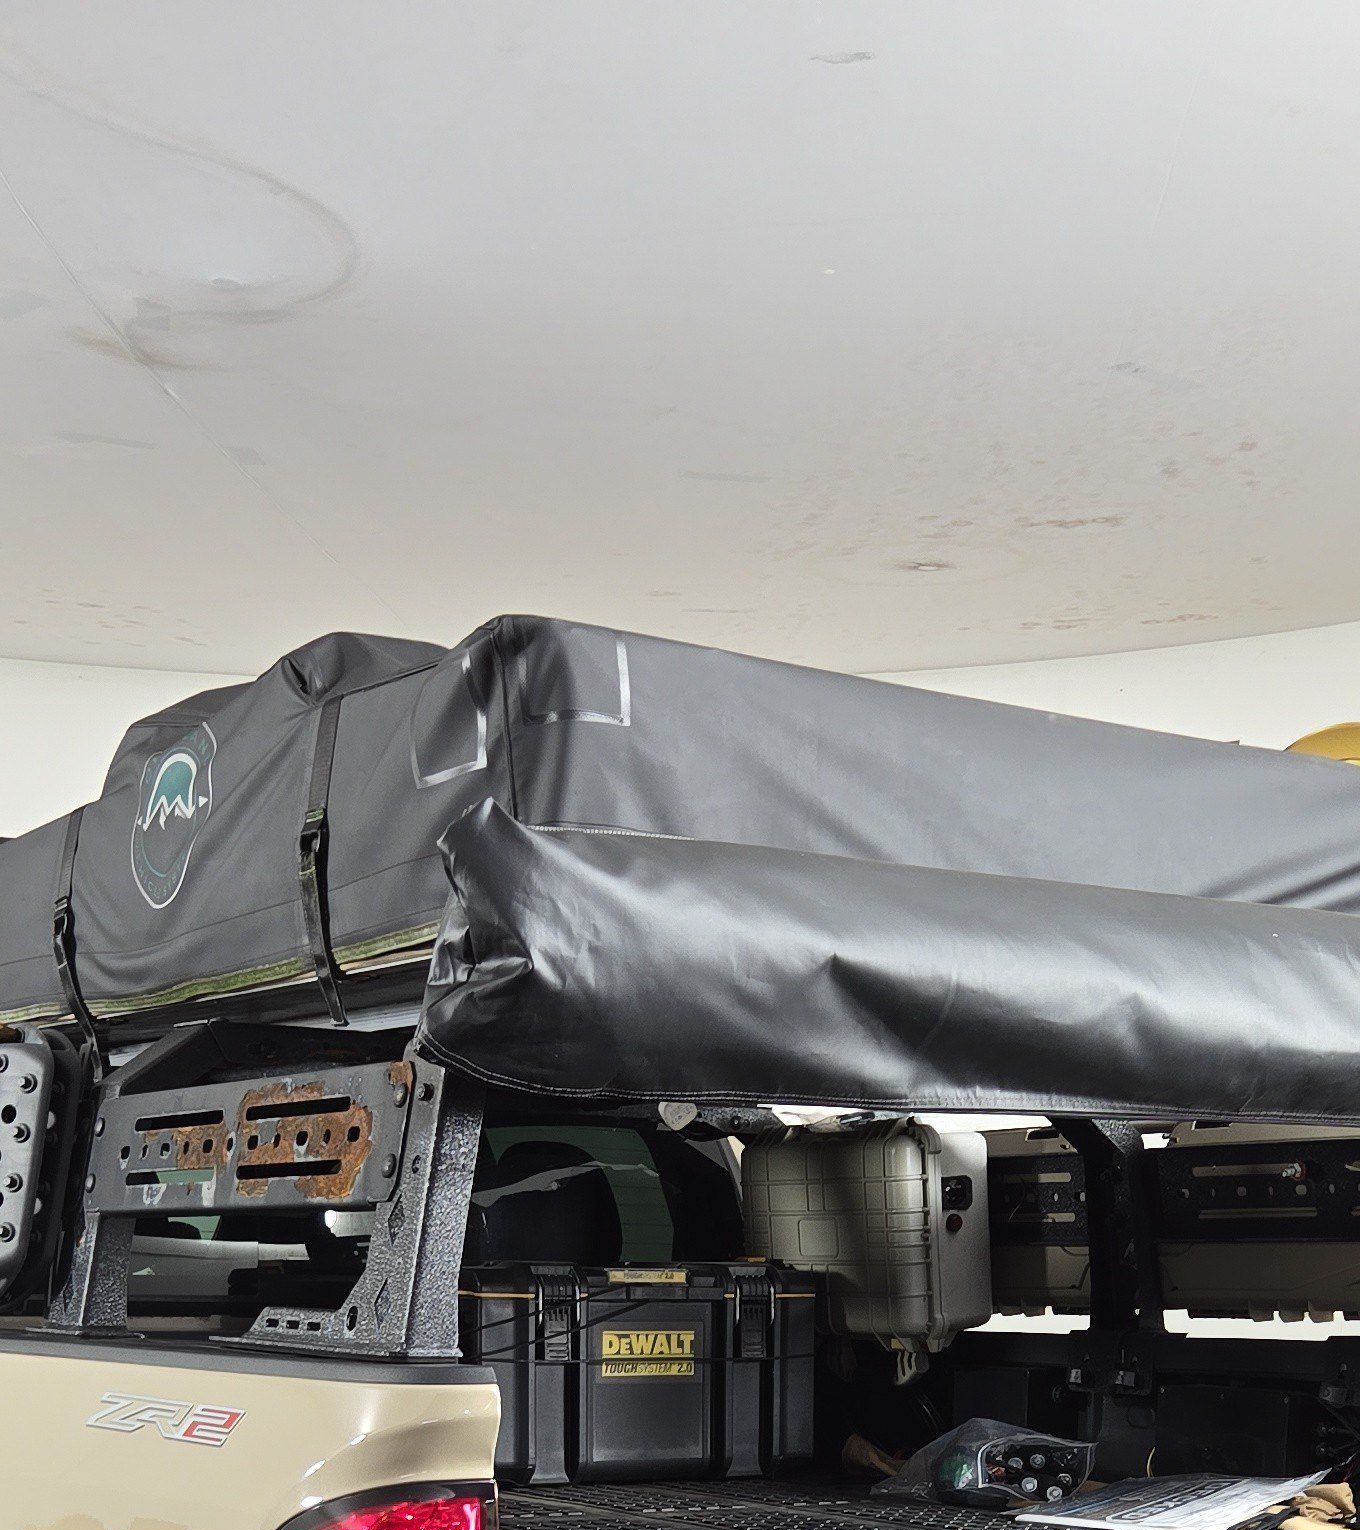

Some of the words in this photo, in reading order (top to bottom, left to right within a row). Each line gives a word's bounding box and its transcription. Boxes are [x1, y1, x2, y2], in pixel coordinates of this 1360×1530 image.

[602, 1333, 695, 1355] DEWALT
[677, 1361, 693, 1373] 2.0
[86, 1391, 246, 1447] ZR2
